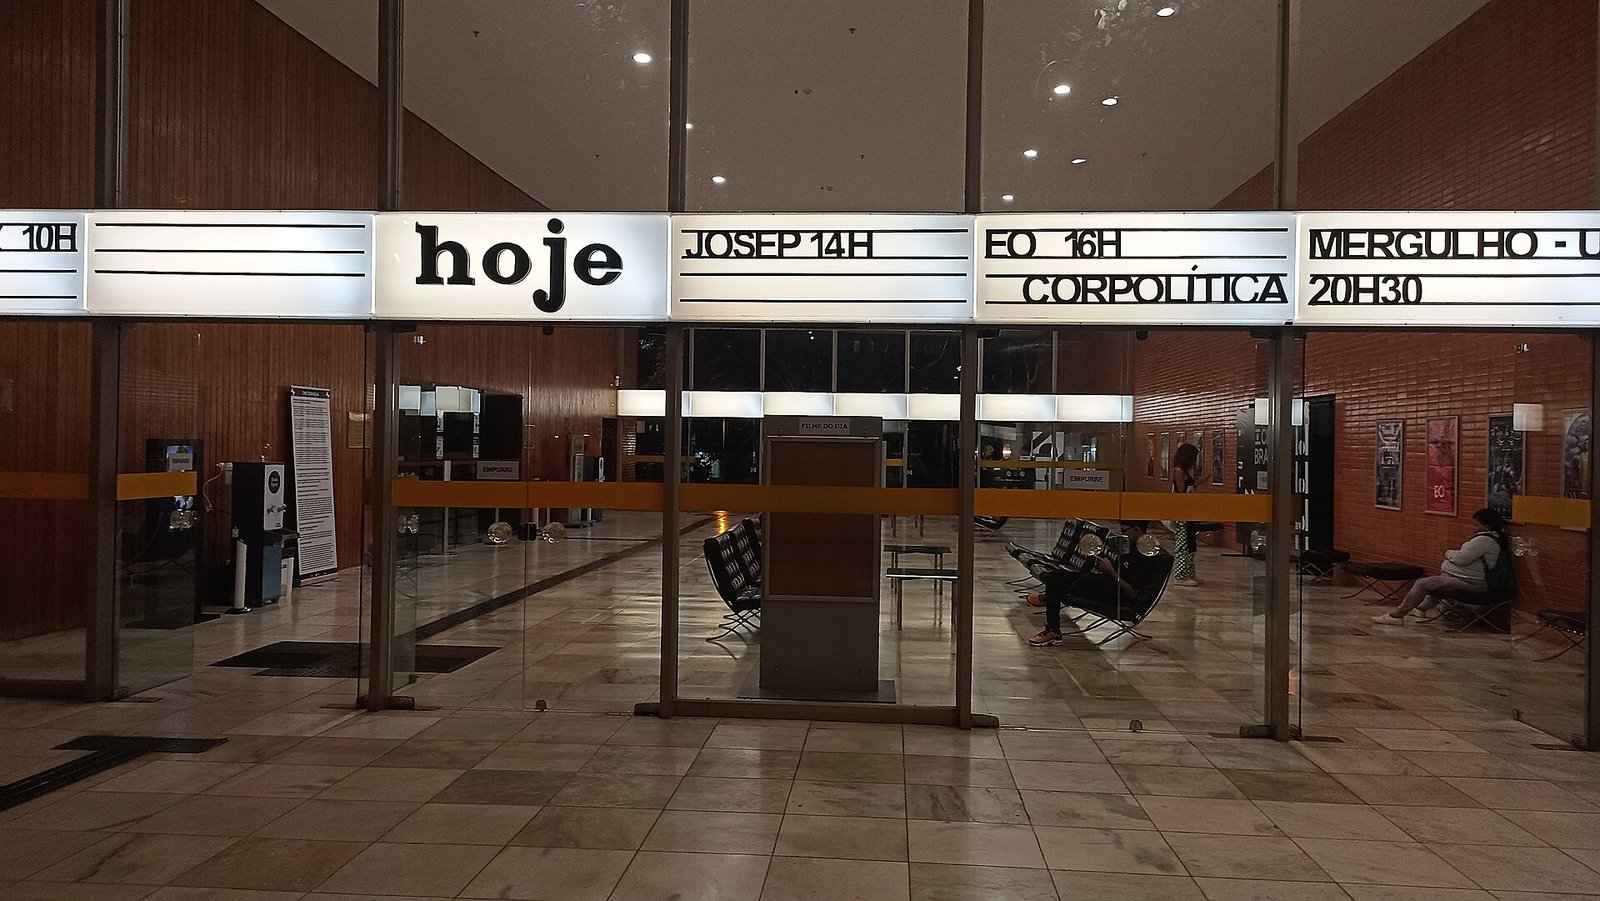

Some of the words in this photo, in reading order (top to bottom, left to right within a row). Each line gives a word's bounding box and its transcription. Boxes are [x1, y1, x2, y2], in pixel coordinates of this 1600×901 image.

[22, 223, 77, 252] 10H
[685, 230, 801, 259] JOSEP
[810, 230, 873, 259] 14H
[985, 229, 1036, 258] EO
[1064, 229, 1122, 258] 16H
[1309, 229, 1538, 259] MERGULHO
[415, 217, 624, 313] hoje
[1022, 264, 1289, 304] CORPOLÍTICA
[1308, 274, 1423, 306] 20H30
[1070, 475, 1104, 483] EMPURRE
